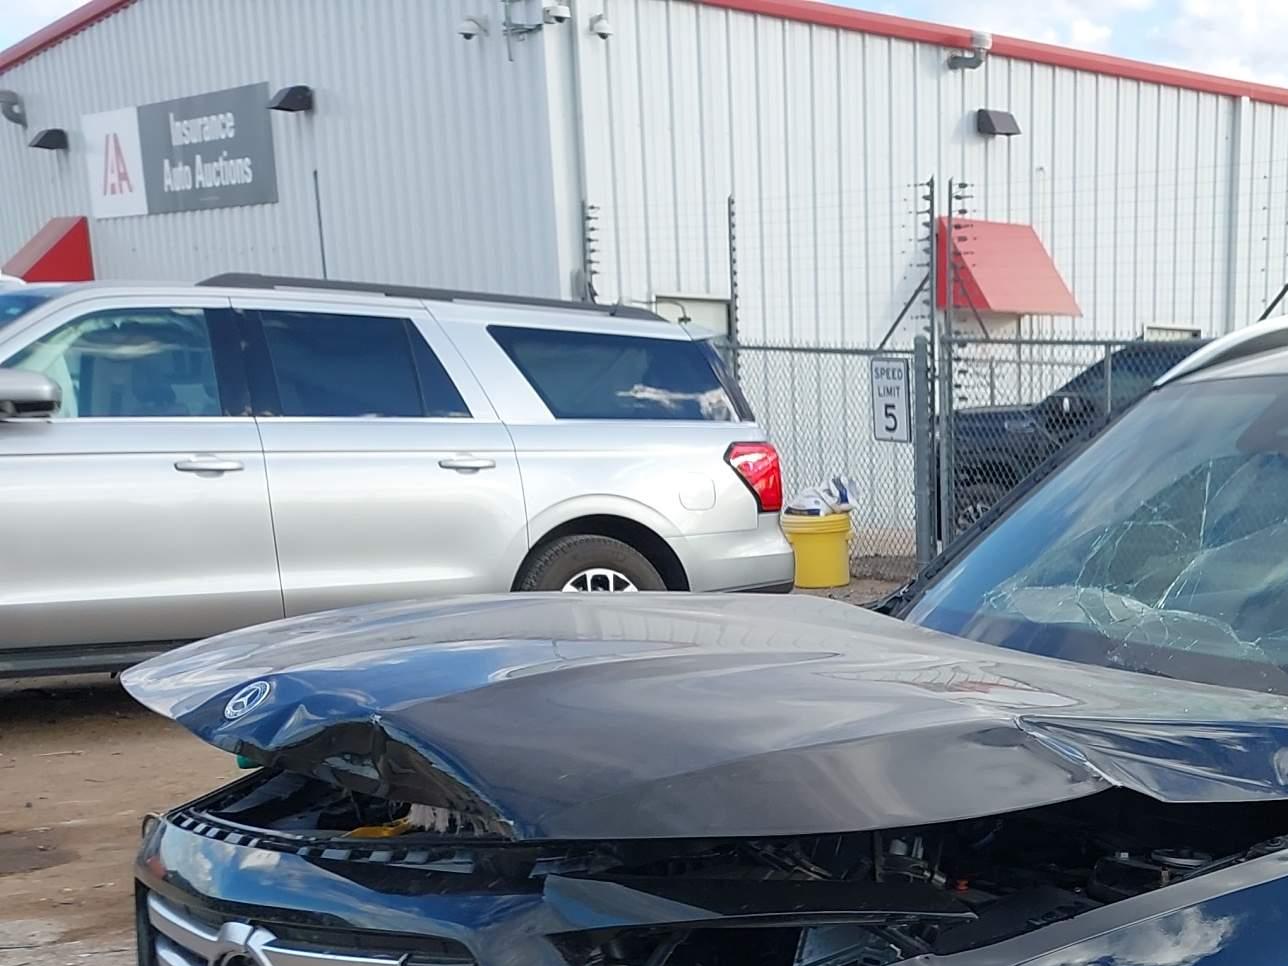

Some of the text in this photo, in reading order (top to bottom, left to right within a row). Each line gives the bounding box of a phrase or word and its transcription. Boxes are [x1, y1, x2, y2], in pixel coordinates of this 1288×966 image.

[169, 111, 236, 147] Insurance
[163, 150, 253, 193] Auto Auctions
[874, 367, 903, 381] SPEED
[877, 385, 901, 398] LIMIT
[884, 403, 898, 433] 5
